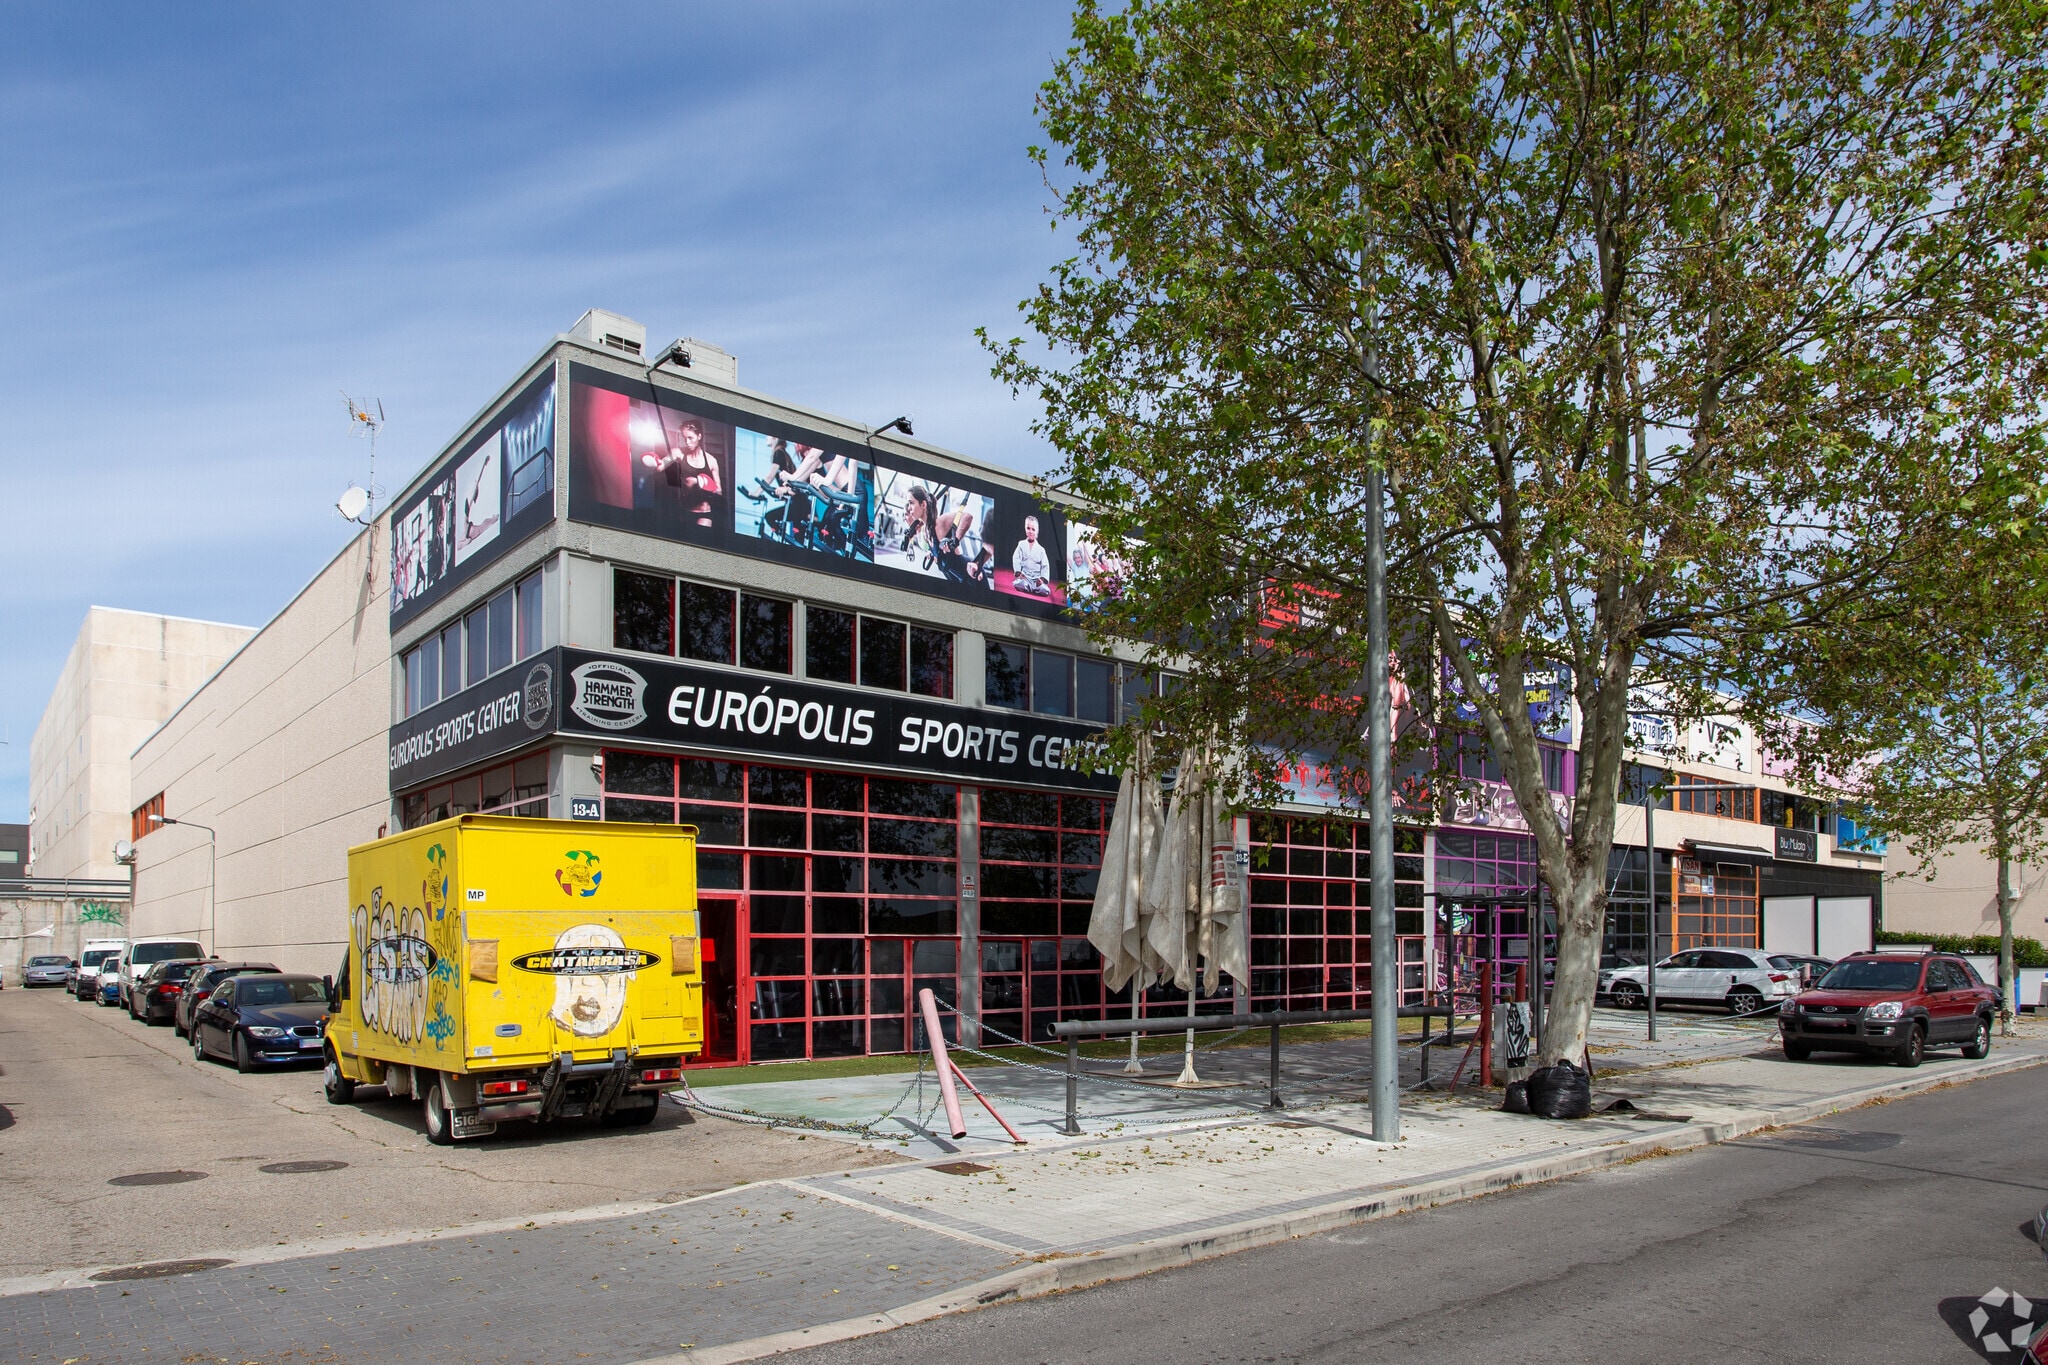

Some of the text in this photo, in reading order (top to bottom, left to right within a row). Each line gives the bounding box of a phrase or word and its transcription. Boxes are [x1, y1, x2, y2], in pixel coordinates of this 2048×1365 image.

[592, 664, 628, 674] OFFICIAL
[585, 681, 633, 697] HAMMER
[583, 693, 635, 709] STRENGTH
[435, 710, 475, 752] SPORTS
[477, 691, 520, 734] CENTER
[579, 710, 640, 727] TRAINING CENTER
[668, 685, 875, 746] EURÓPOLIS
[899, 717, 1019, 763] SPORTS
[573, 803, 599, 817] 13-A
[468, 891, 484, 900] MP
